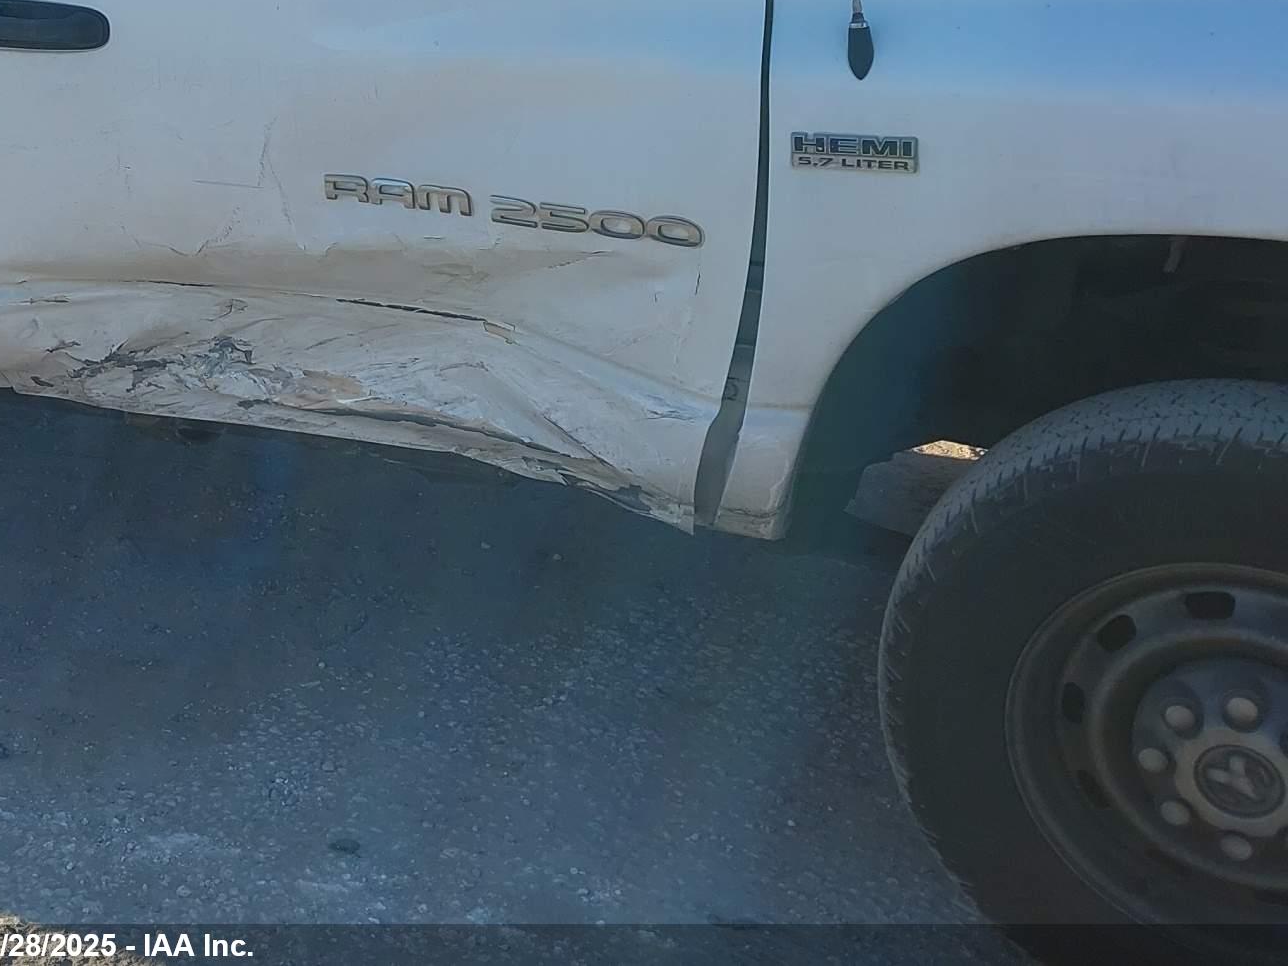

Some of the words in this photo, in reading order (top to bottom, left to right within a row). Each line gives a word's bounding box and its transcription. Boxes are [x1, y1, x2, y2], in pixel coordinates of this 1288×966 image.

[792, 134, 914, 157] HEMI
[797, 155, 834, 167] 5.7
[840, 157, 911, 172] LITER
[323, 173, 473, 217] RAM
[489, 194, 704, 248] 2500
